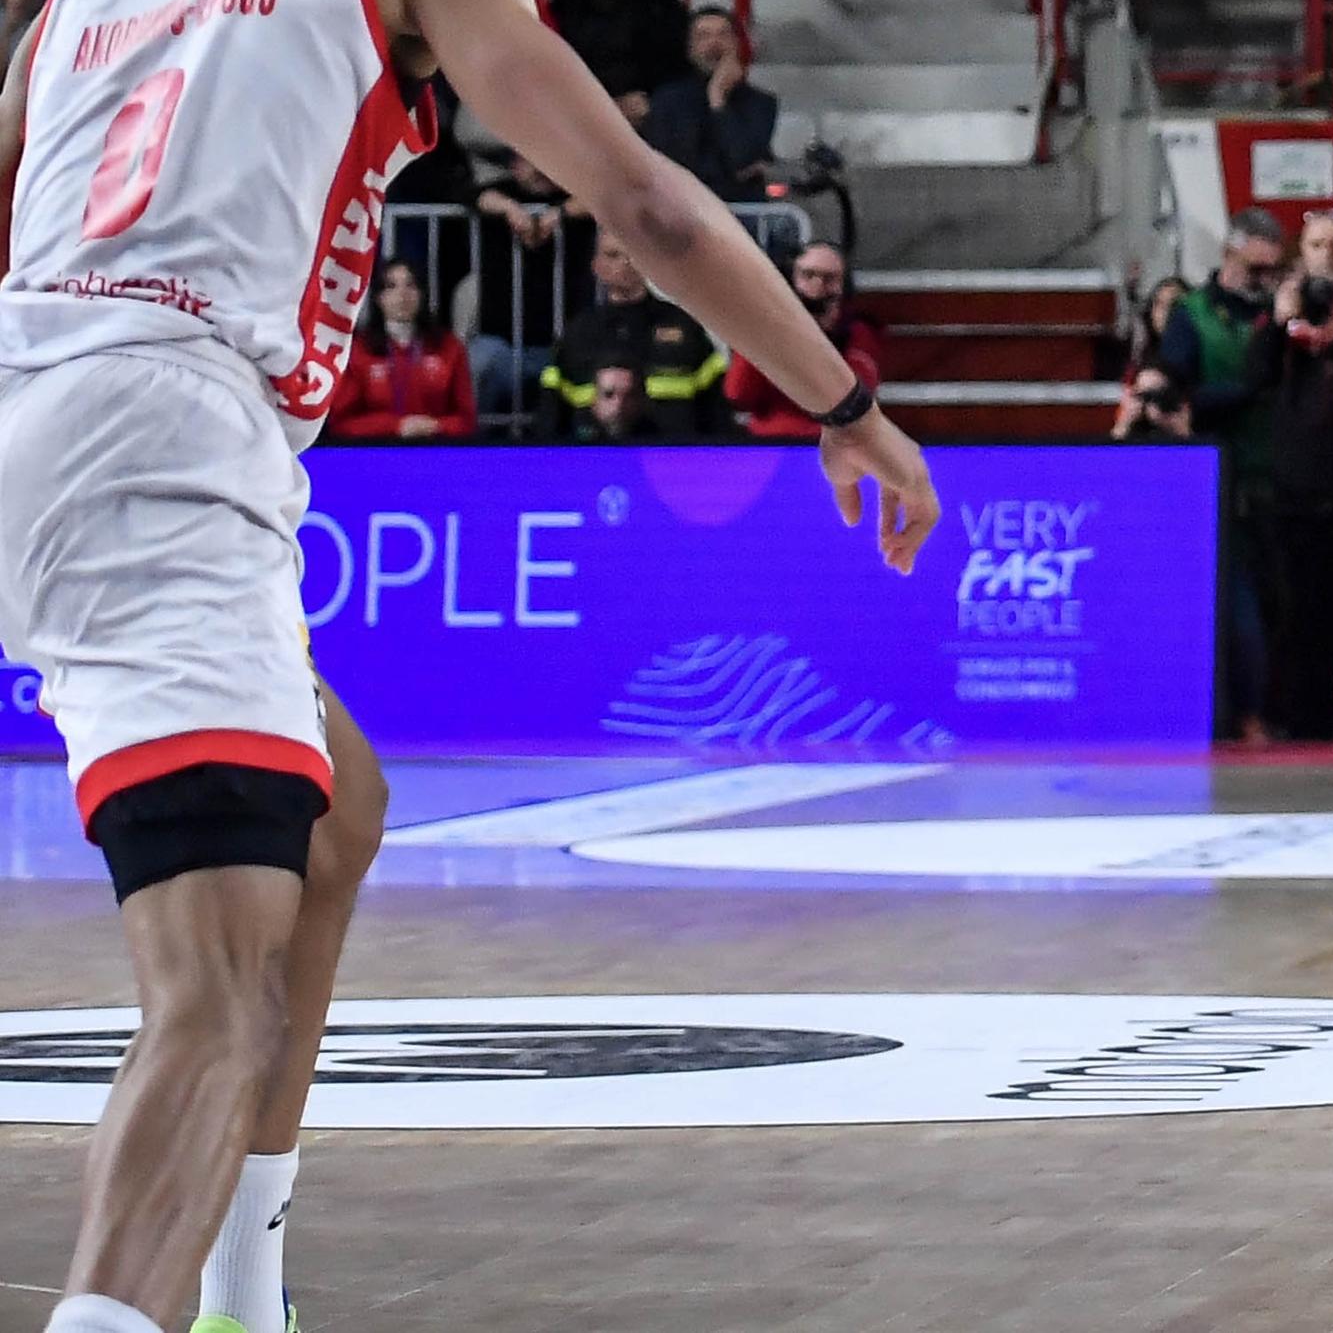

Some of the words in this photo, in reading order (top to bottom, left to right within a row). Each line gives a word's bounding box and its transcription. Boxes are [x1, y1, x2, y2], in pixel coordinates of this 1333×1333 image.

[82, 67, 185, 240] 0
[960, 499, 1089, 549] VERY
[957, 547, 1095, 603] FAST
[957, 598, 1083, 637] PEOPLE
